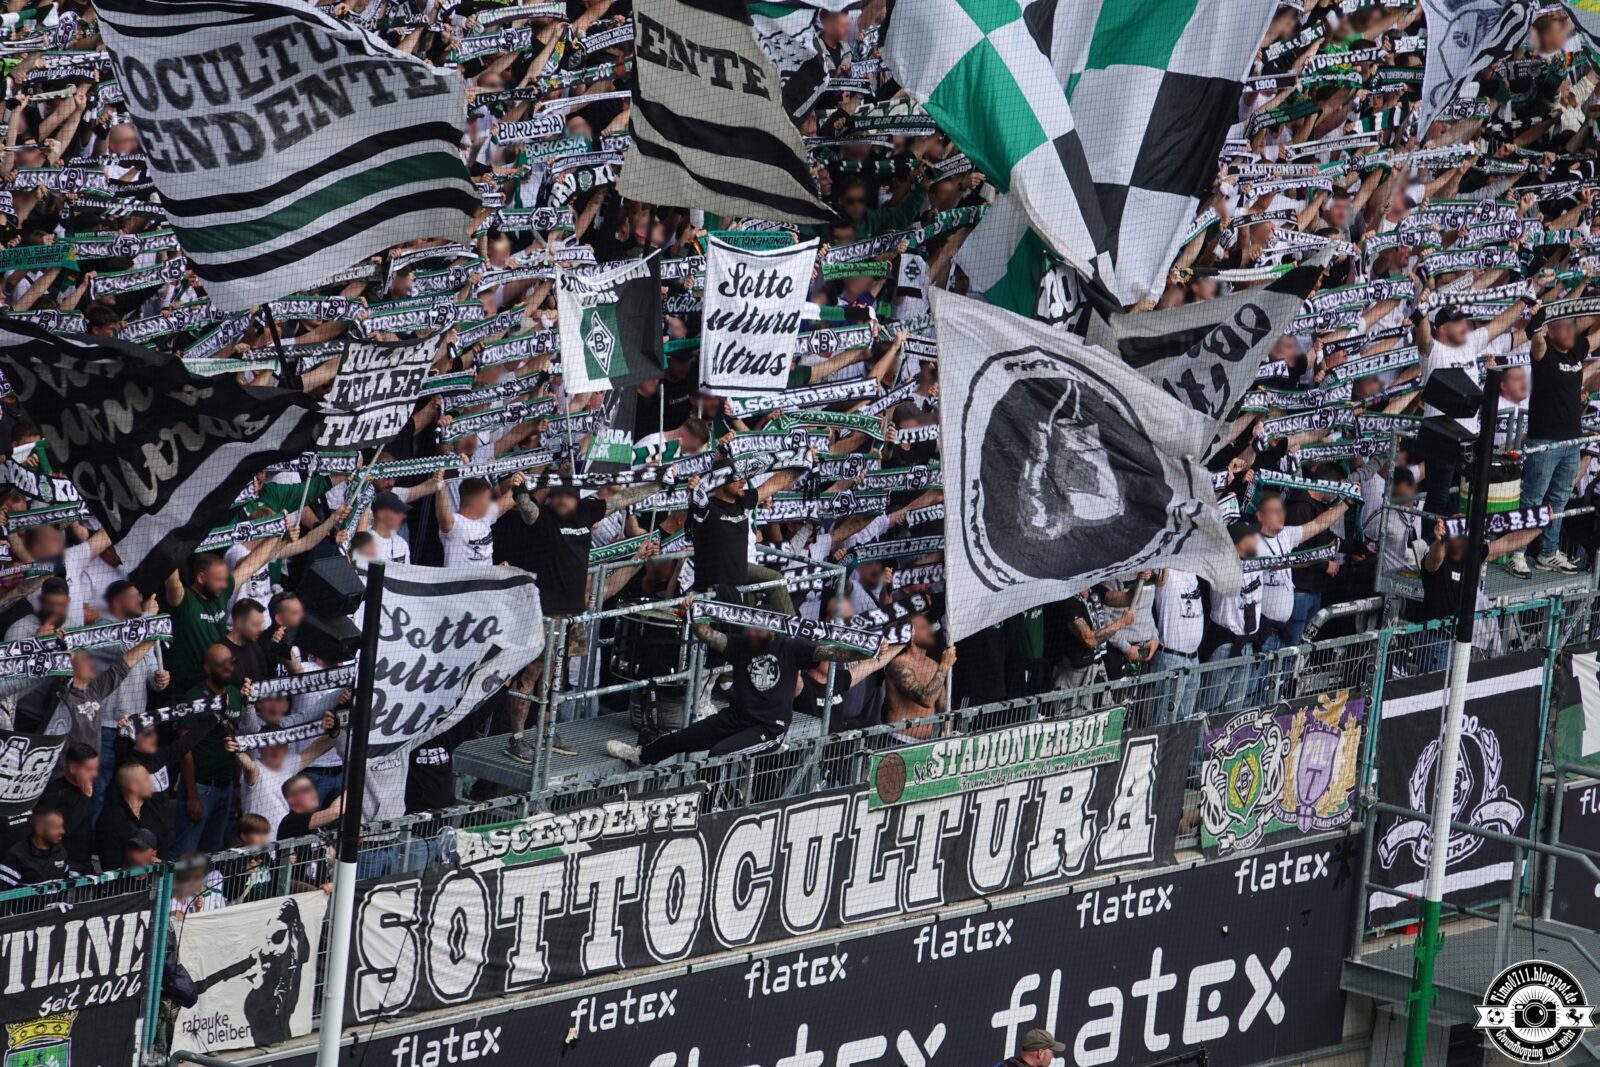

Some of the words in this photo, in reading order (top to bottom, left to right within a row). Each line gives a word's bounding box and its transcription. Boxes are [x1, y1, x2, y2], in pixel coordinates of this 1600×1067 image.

[110, 20, 366, 111] OCULTU
[636, 12, 772, 101] ENTE
[1255, 79, 1277, 90] 1900
[499, 115, 562, 140] BORUSSIA
[525, 137, 587, 158] BORUSSIA
[717, 262, 794, 299] Sotto
[712, 340, 787, 376] Ultras
[839, 330, 871, 347] FANS
[331, 368, 428, 409] KELLER
[731, 378, 878, 417] ASCENDENTE
[316, 403, 417, 447] FLUTEN
[693, 602, 781, 630] BORUSSIA
[832, 627, 878, 650] FANS
[931, 711, 1110, 779] STADIONVERBOT
[1580, 787, 1600, 815] fl
[461, 793, 701, 863] ASCENDENTE
[354, 735, 1159, 1021] SOTTOCULTURA
[38, 987, 81, 1017] seit
[85, 974, 141, 1005] 2006
[182, 1012, 229, 1033] rabauke
